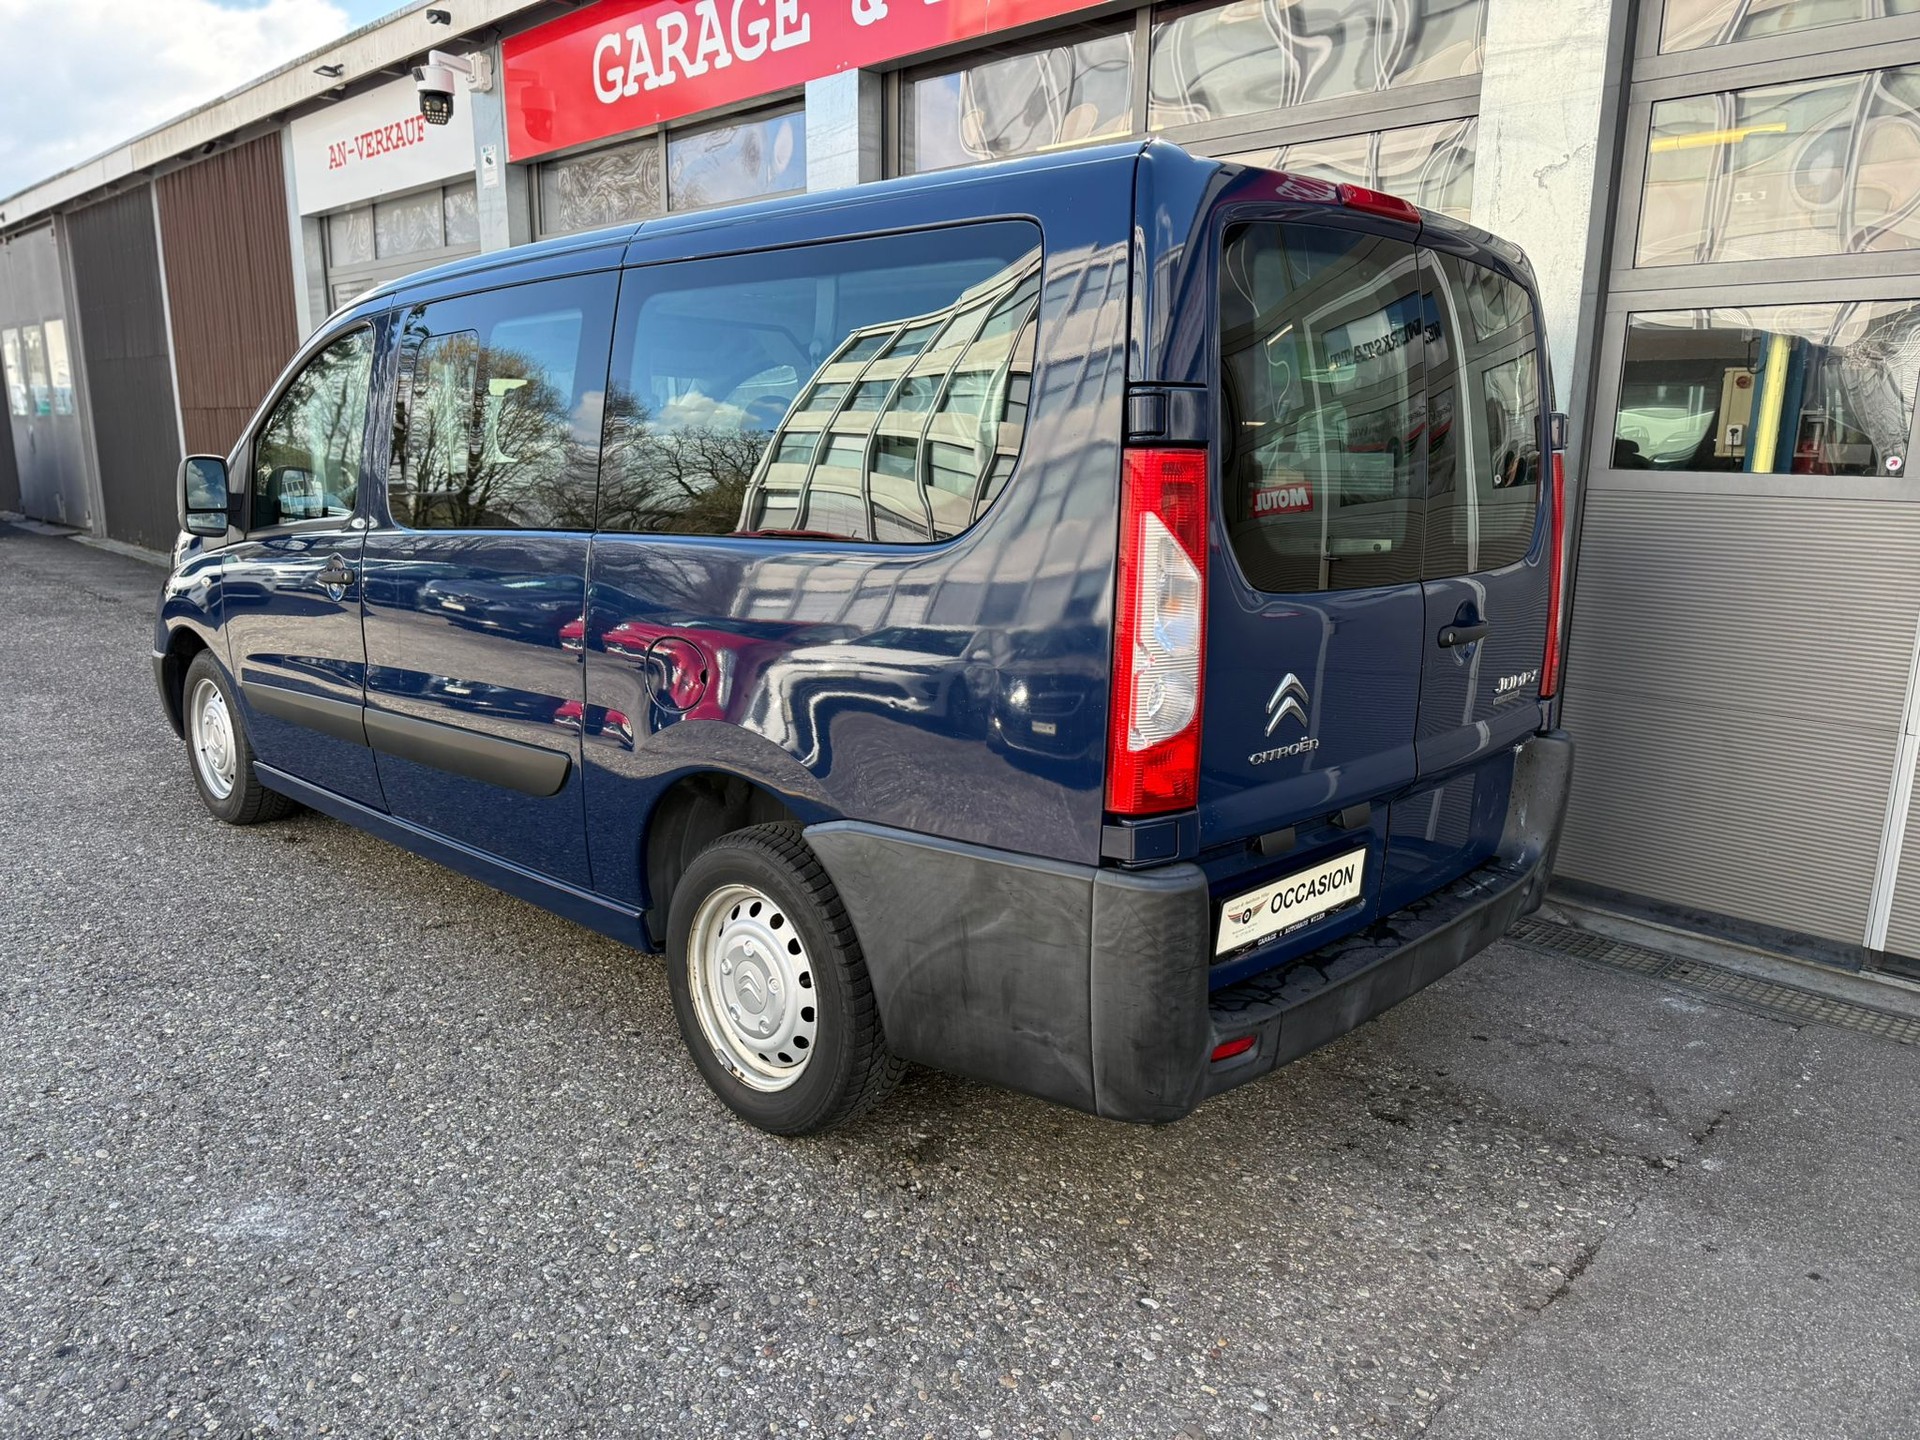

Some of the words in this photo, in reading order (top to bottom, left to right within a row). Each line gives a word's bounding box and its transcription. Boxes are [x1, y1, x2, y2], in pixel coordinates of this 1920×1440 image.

[592, 0, 811, 103] GARAGE
[328, 114, 427, 169] AN-VERKAUF
[1248, 736, 1319, 766] CITROËN
[1270, 864, 1355, 914] OCCASION
